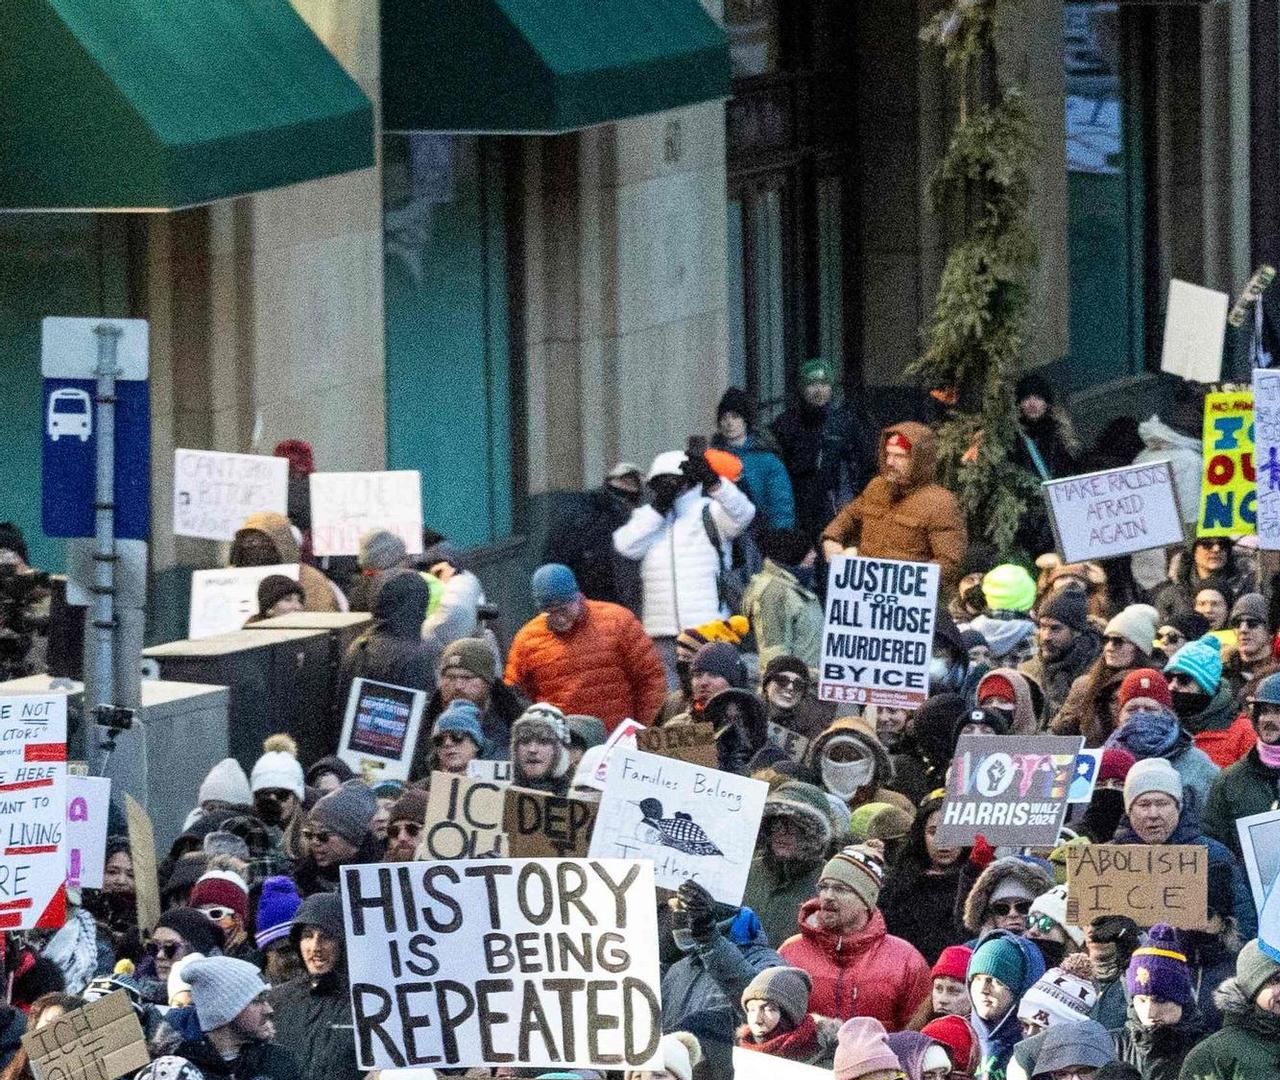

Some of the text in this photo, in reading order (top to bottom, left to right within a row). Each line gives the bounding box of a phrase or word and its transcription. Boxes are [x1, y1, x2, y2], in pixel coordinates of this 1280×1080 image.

[1053, 479, 1101, 502] MAKE
[1086, 497, 1145, 521] AFRAID
[1088, 518, 1147, 546] AGAIN
[835, 558, 927, 598] JUSTICE
[829, 604, 931, 634] ALL THOSE
[826, 633, 926, 666] MURDERED
[824, 663, 925, 689] BY ICE
[16, 767, 56, 781] HERE
[622, 757, 744, 812] Families Belong
[944, 802, 1062, 827] HARRIS WALZ
[1028, 814, 1059, 826] 2024
[9, 823, 62, 846] LIVING
[345, 861, 641, 939] HISTORY
[1089, 884, 1186, 911] ICE
[387, 930, 632, 979] IS BEING
[350, 976, 663, 1069] REPEATED
